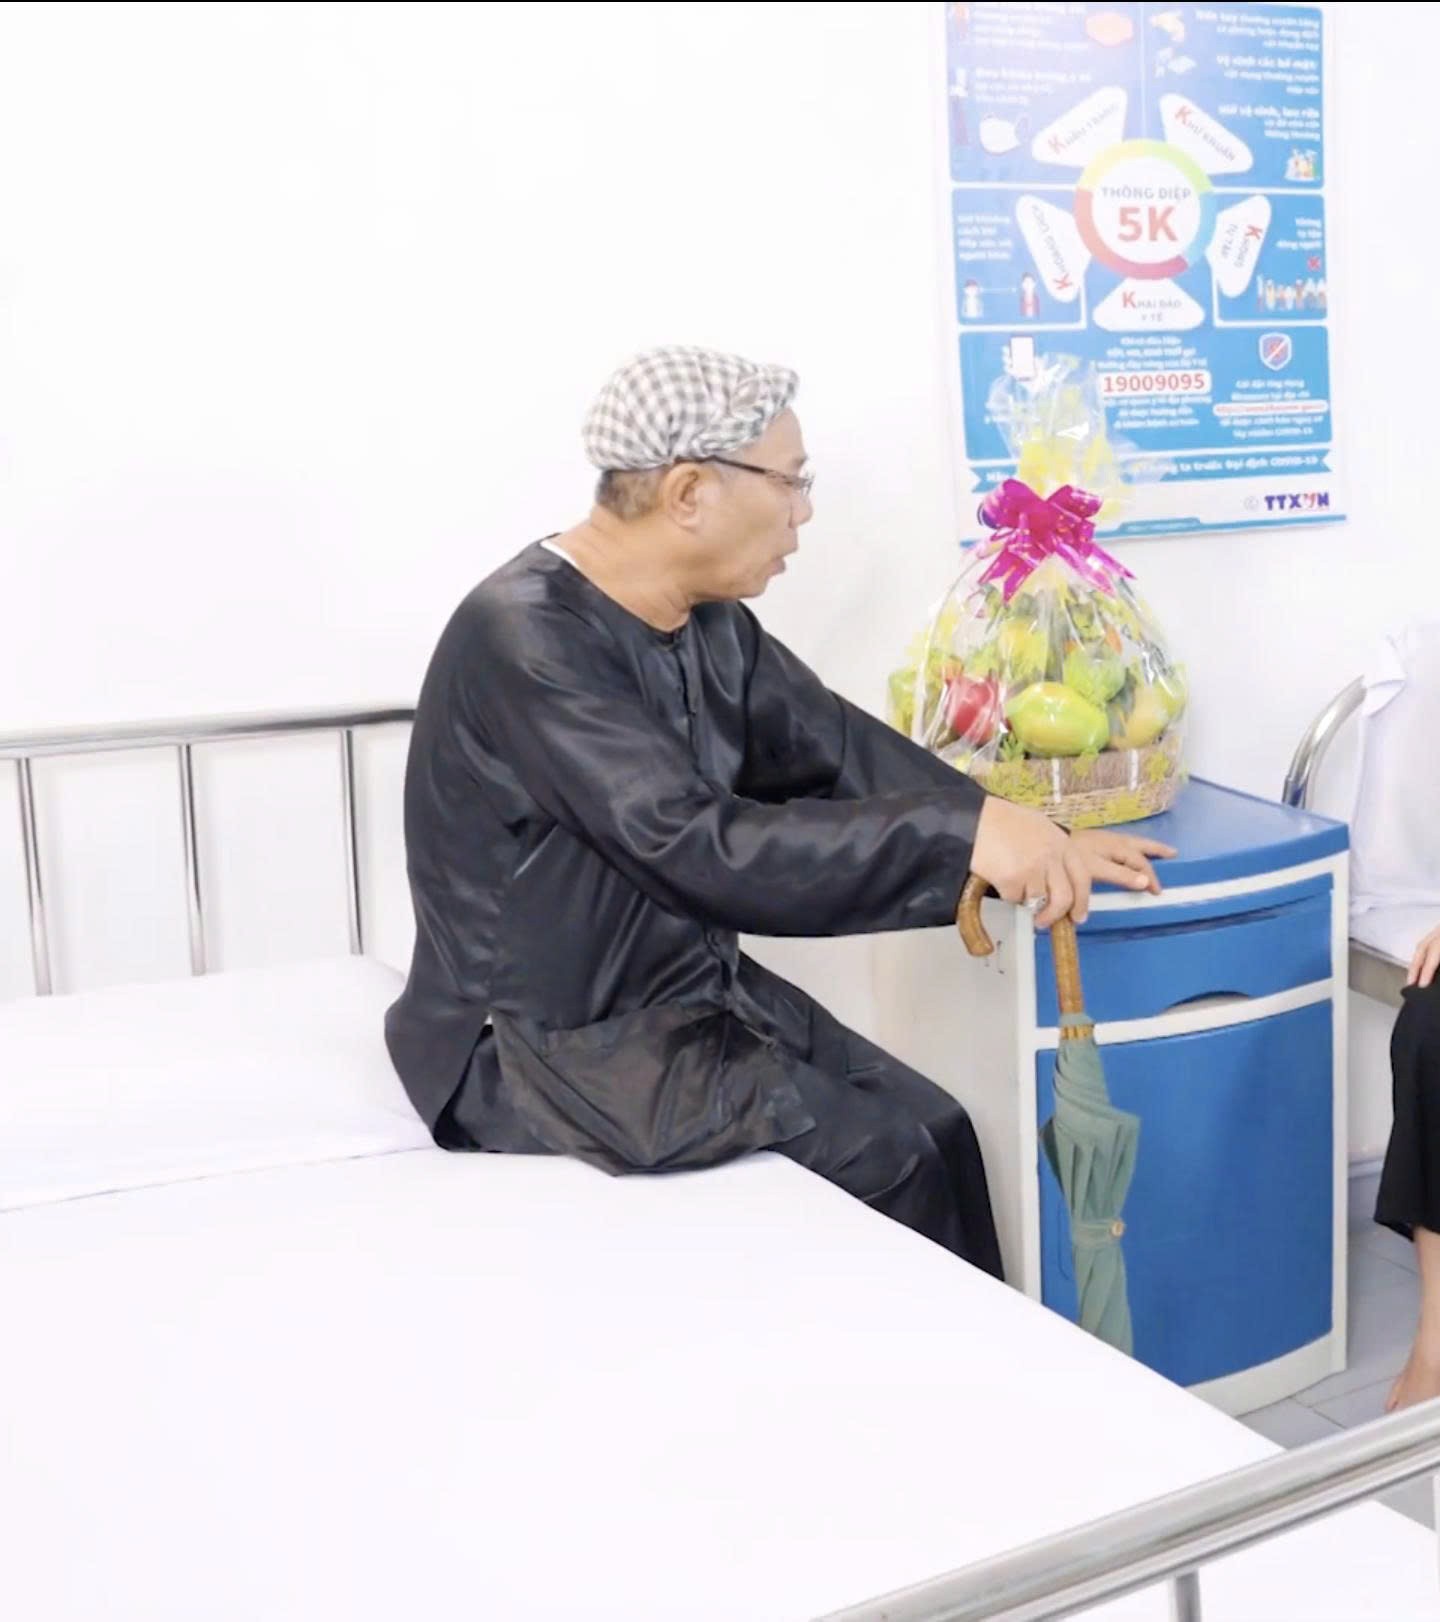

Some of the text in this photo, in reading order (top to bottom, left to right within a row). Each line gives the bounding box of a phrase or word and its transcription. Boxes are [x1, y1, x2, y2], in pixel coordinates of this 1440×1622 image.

[1101, 184, 1192, 203] THÔNG ĐIỆP
[1117, 206, 1178, 242] 5K
[1122, 291, 1157, 309] KHAI
[1103, 373, 1205, 393] 19009095
